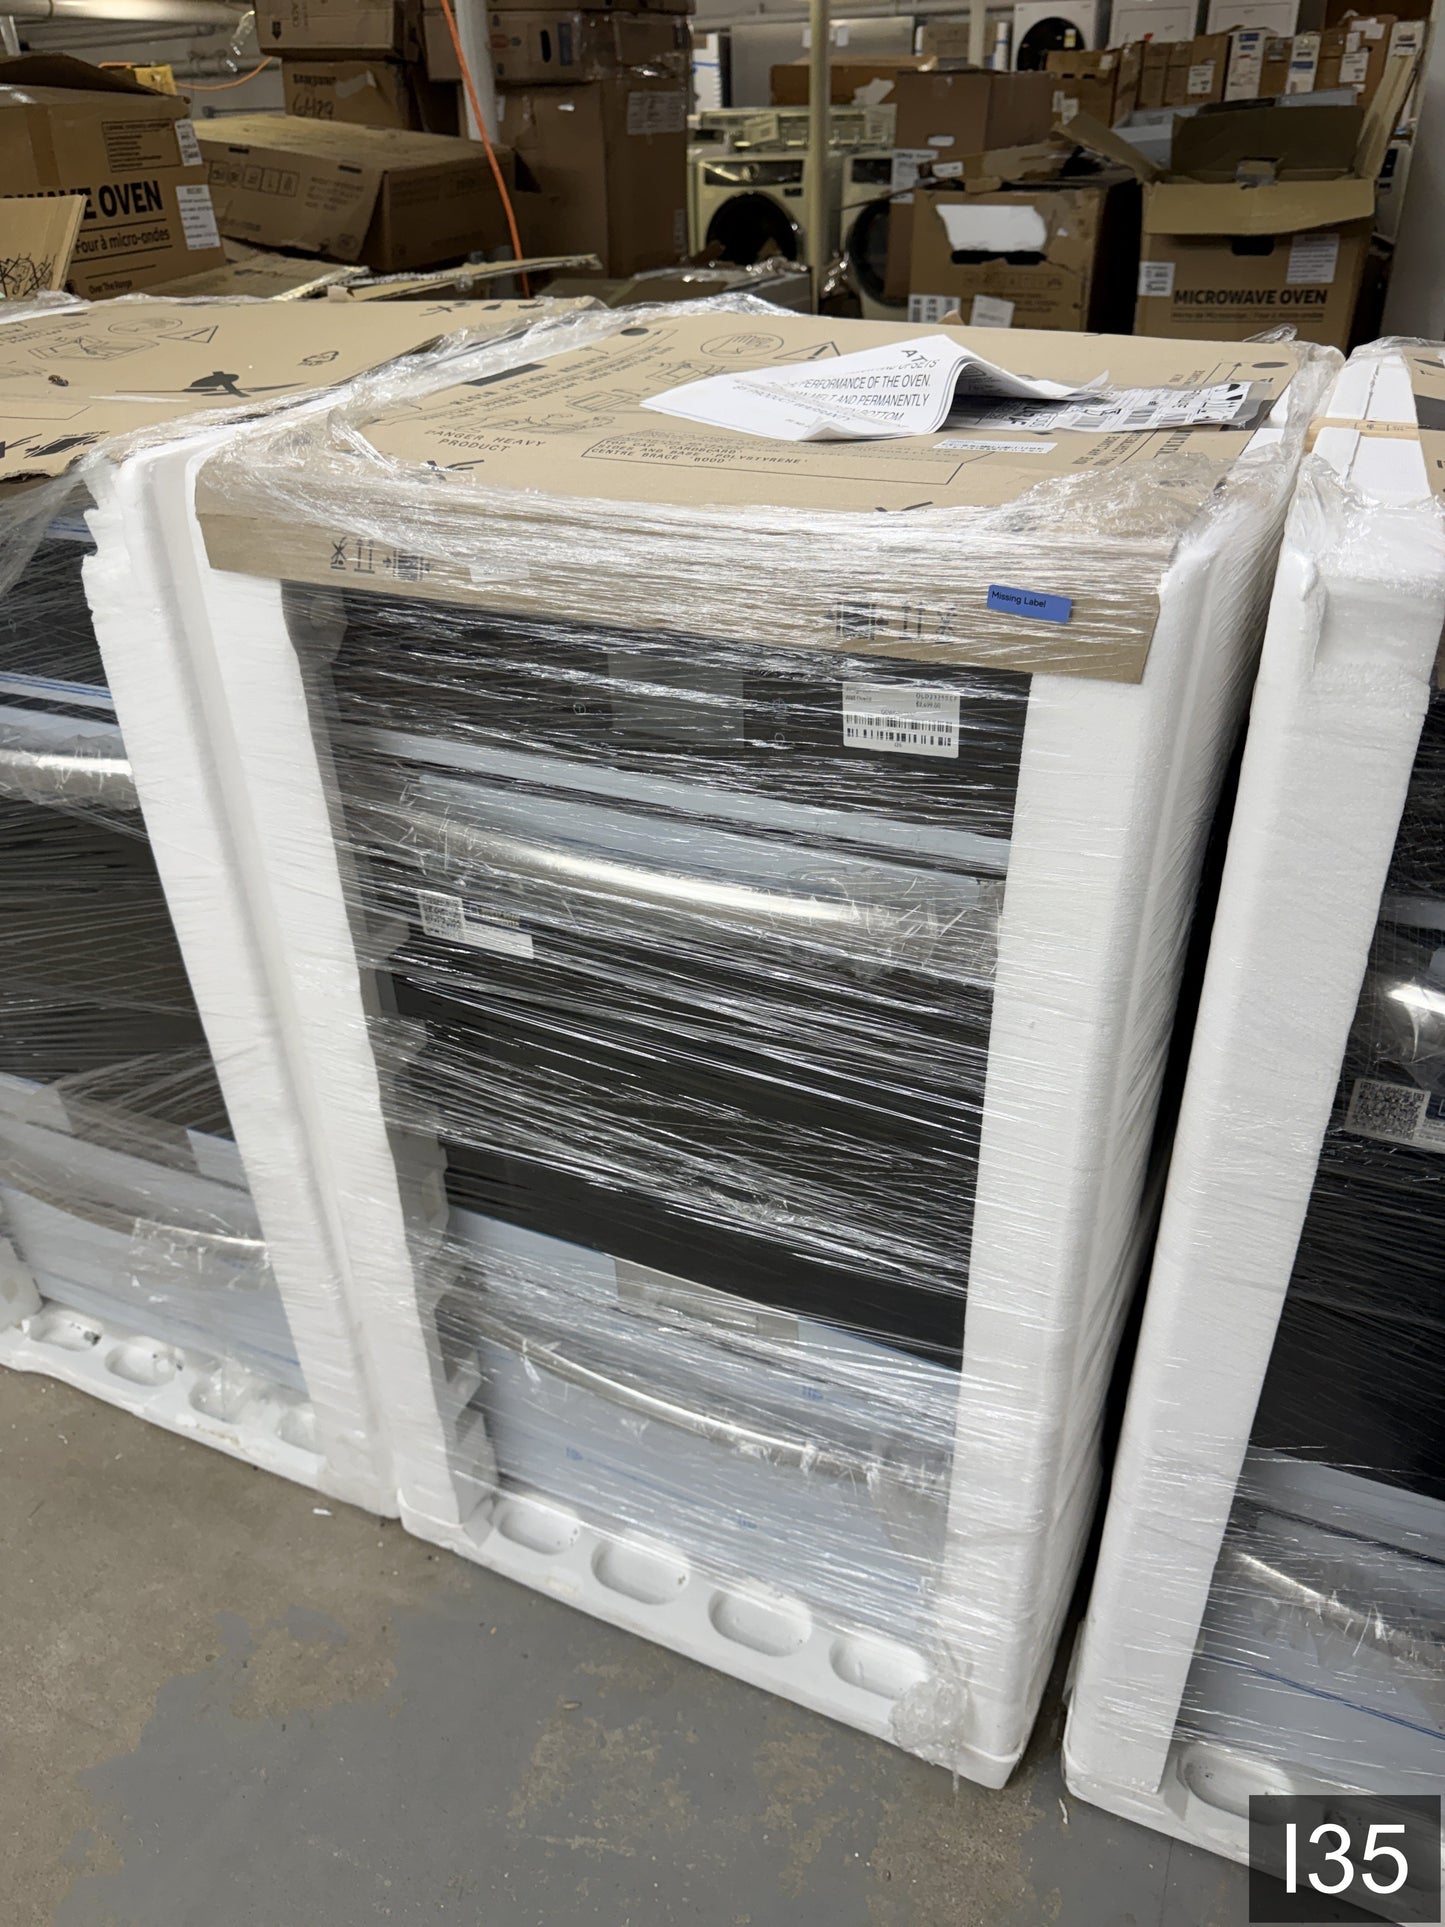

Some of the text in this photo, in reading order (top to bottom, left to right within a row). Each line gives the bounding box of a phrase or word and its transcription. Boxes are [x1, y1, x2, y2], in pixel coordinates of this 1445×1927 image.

[99, 180, 164, 217] OVEN
[76, 237, 99, 254] Four
[109, 228, 171, 249] micro-ondes
[1173, 289, 1328, 305] MICROWAVE OVEN
[799, 376, 866, 390] PERFORMANCE
[866, 375, 881, 389] OF
[882, 375, 901, 388] THE
[901, 373, 931, 388] OVEN.
[836, 394, 858, 406] AND
[857, 393, 930, 407] PERMANENTLY
[424, 429, 547, 447] DANGER HEAVY
[438, 438, 511, 452] PRODUCT
[591, 448, 634, 457] CENTRE
[598, 444, 634, 452] SIDES
[991, 591, 1047, 608] Missing Label
